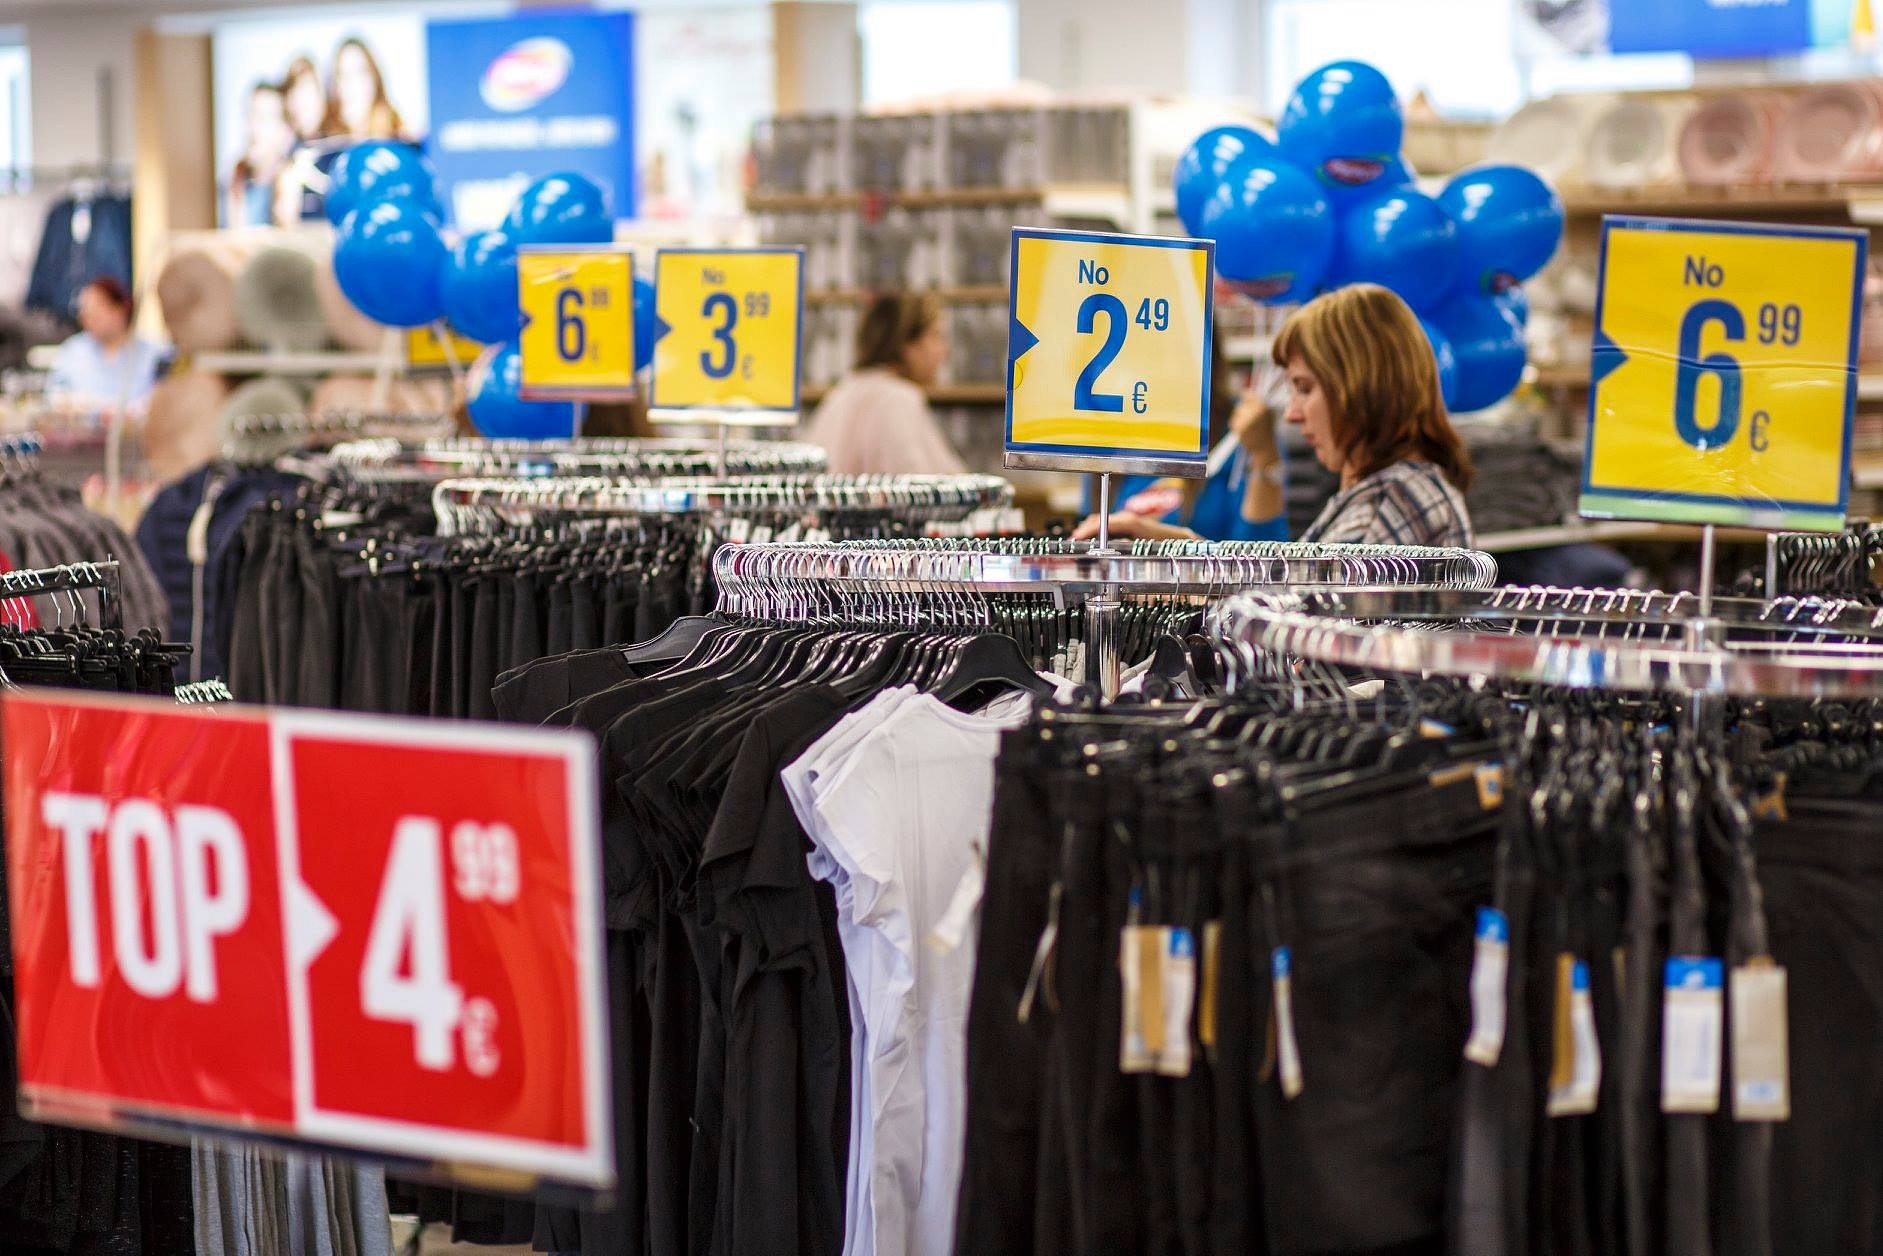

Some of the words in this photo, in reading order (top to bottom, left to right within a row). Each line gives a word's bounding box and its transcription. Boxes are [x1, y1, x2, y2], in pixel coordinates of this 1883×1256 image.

[701, 268, 725, 284] No
[1078, 260, 1109, 285] No
[1683, 255, 1724, 287] No
[557, 287, 586, 363] 6
[700, 292, 738, 378] 3
[745, 291, 771, 317] 99
[1135, 298, 1169, 331] 49
[1757, 303, 1801, 345] 99
[1074, 293, 1128, 412] 2
[1674, 298, 1746, 450] 6
[1132, 381, 1147, 413] €
[1750, 410, 1770, 452] €
[41, 790, 250, 1002] TOP
[361, 816, 464, 1070] 4
[452, 820, 521, 905] 99
